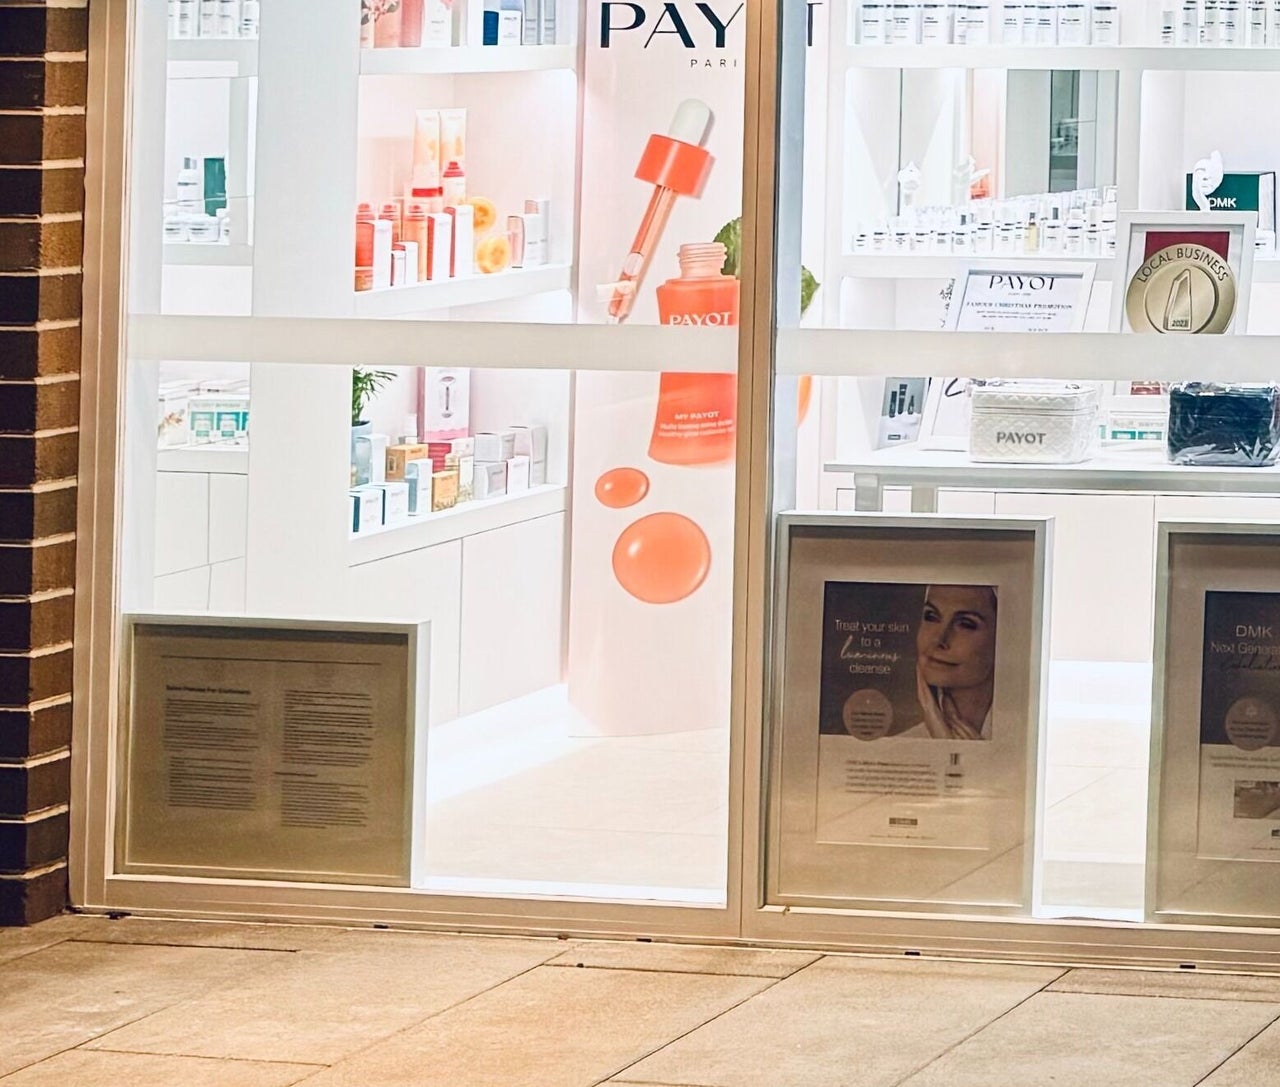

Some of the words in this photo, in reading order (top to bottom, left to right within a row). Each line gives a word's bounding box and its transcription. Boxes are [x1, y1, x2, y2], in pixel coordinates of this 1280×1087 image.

[1137, 251, 1173, 283] LOCAL
[1176, 247, 1229, 282] BUSINESS
[989, 275, 1056, 291] PAYOT
[997, 432, 1046, 444] PAYOT
[836, 619, 859, 631] Treat
[1236, 625, 1272, 637] DMK
[861, 637, 871, 647] to
[849, 664, 891, 674] cleanse
